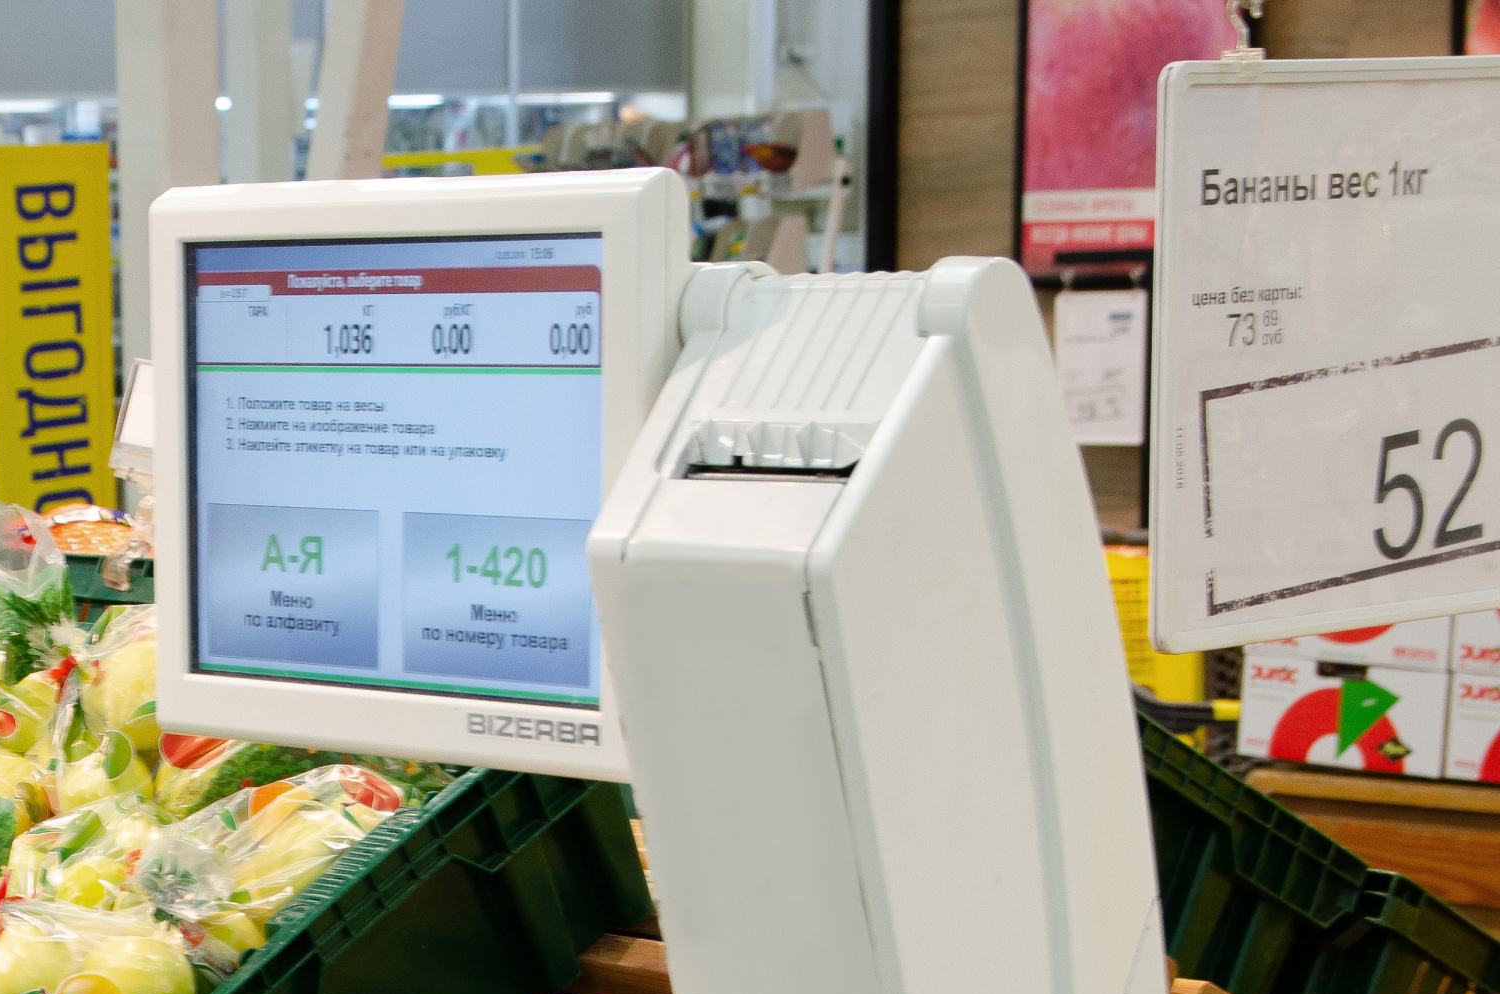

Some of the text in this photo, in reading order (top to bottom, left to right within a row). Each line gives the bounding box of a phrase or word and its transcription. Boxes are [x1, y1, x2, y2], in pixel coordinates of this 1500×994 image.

[1200, 160, 1431, 207] Бананы вес 1кг
[1191, 290, 1226, 309] цена
[1230, 285, 1255, 304] без
[248, 305, 269, 317] ТАРА
[1262, 309, 1280, 327] 69
[324, 323, 375, 358] 1,036
[432, 323, 472, 358] 0,00
[550, 322, 593, 358] 0,00
[1226, 312, 1258, 347] 73
[238, 396, 295, 410] Положите
[299, 400, 332, 414] товар
[336, 401, 350, 412] на
[354, 401, 385, 412] весы
[238, 418, 289, 431] Нажмите
[292, 420, 306, 432] на
[309, 419, 389, 436] изображение
[392, 423, 436, 437] товара
[238, 438, 292, 452] Наклейте
[294, 442, 343, 457] этикетку
[347, 444, 361, 455] на
[365, 444, 399, 458] товар
[403, 445, 427, 456] или
[430, 446, 445, 457] на
[448, 446, 506, 462] упаковку
[1372, 417, 1484, 560] 52
[260, 533, 324, 575] А-Я
[446, 543, 548, 588] 1-420
[270, 590, 313, 609] Меню
[244, 612, 342, 637] по алфавиту
[470, 603, 518, 624] Меню
[421, 627, 569, 654] по номеру товара
[467, 711, 600, 747] BIZERBA
